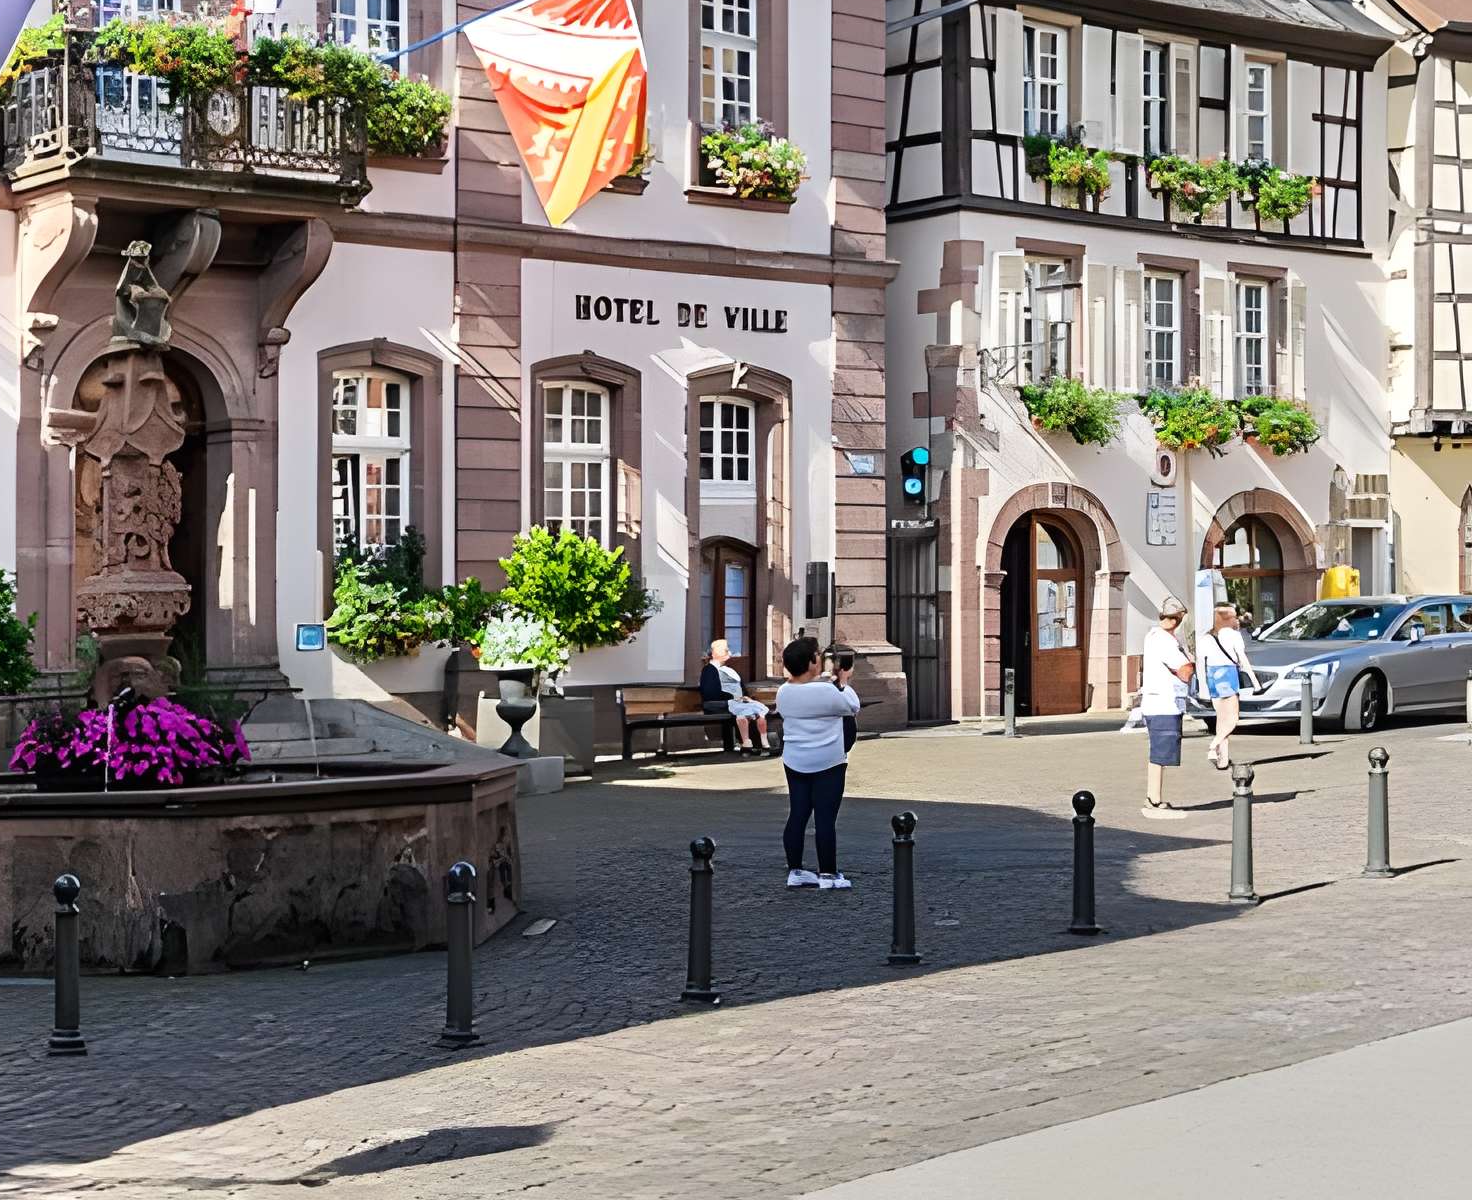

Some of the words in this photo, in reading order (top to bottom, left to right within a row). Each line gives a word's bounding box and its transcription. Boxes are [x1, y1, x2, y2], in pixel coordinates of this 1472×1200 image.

[576, 294, 660, 325] HOTEL
[678, 303, 708, 328] DE
[724, 306, 788, 333] VILLE
